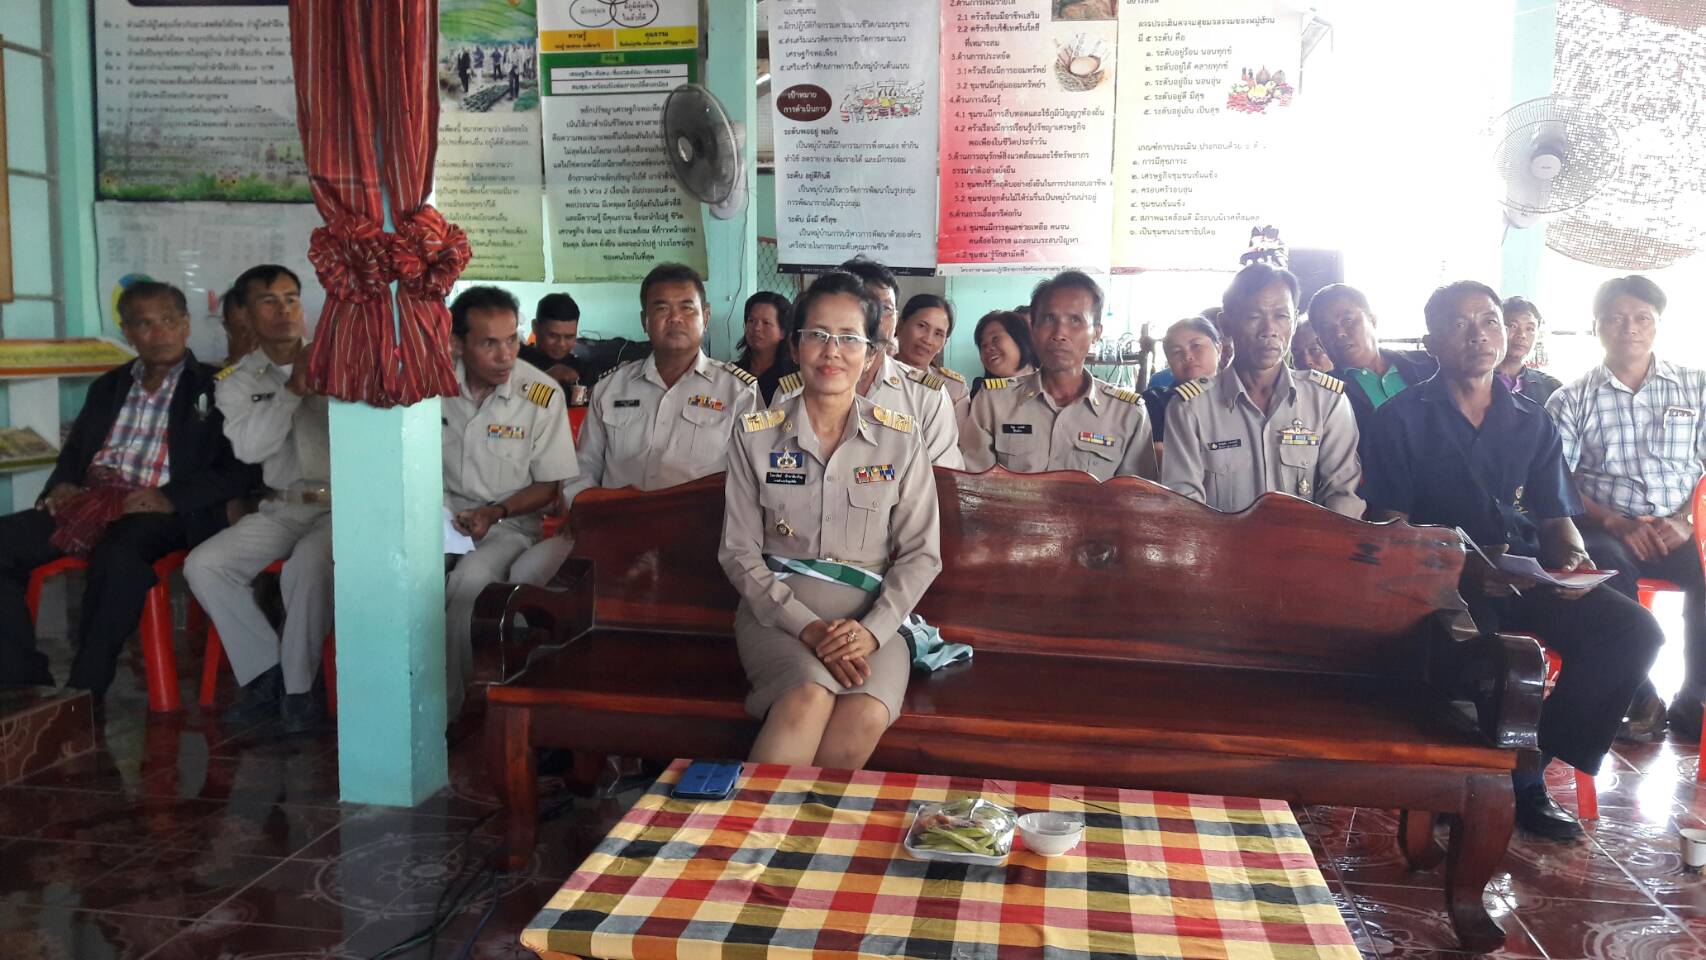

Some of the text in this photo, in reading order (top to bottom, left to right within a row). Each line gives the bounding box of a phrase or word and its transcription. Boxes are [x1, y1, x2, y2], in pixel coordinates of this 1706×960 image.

[957, 13, 968, 21] 2.1
[957, 25, 969, 33] 2.2
[1154, 32, 1174, 42] ระดับ
[1175, 31, 1186, 42] คือ
[964, 37, 1000, 48] ที่เหมาะสม
[787, 89, 818, 100] เป้าหมาย
[783, 103, 827, 114] การดำเนินการ
[955, 111, 966, 119] 4.1
[954, 124, 966, 133] 4.2
